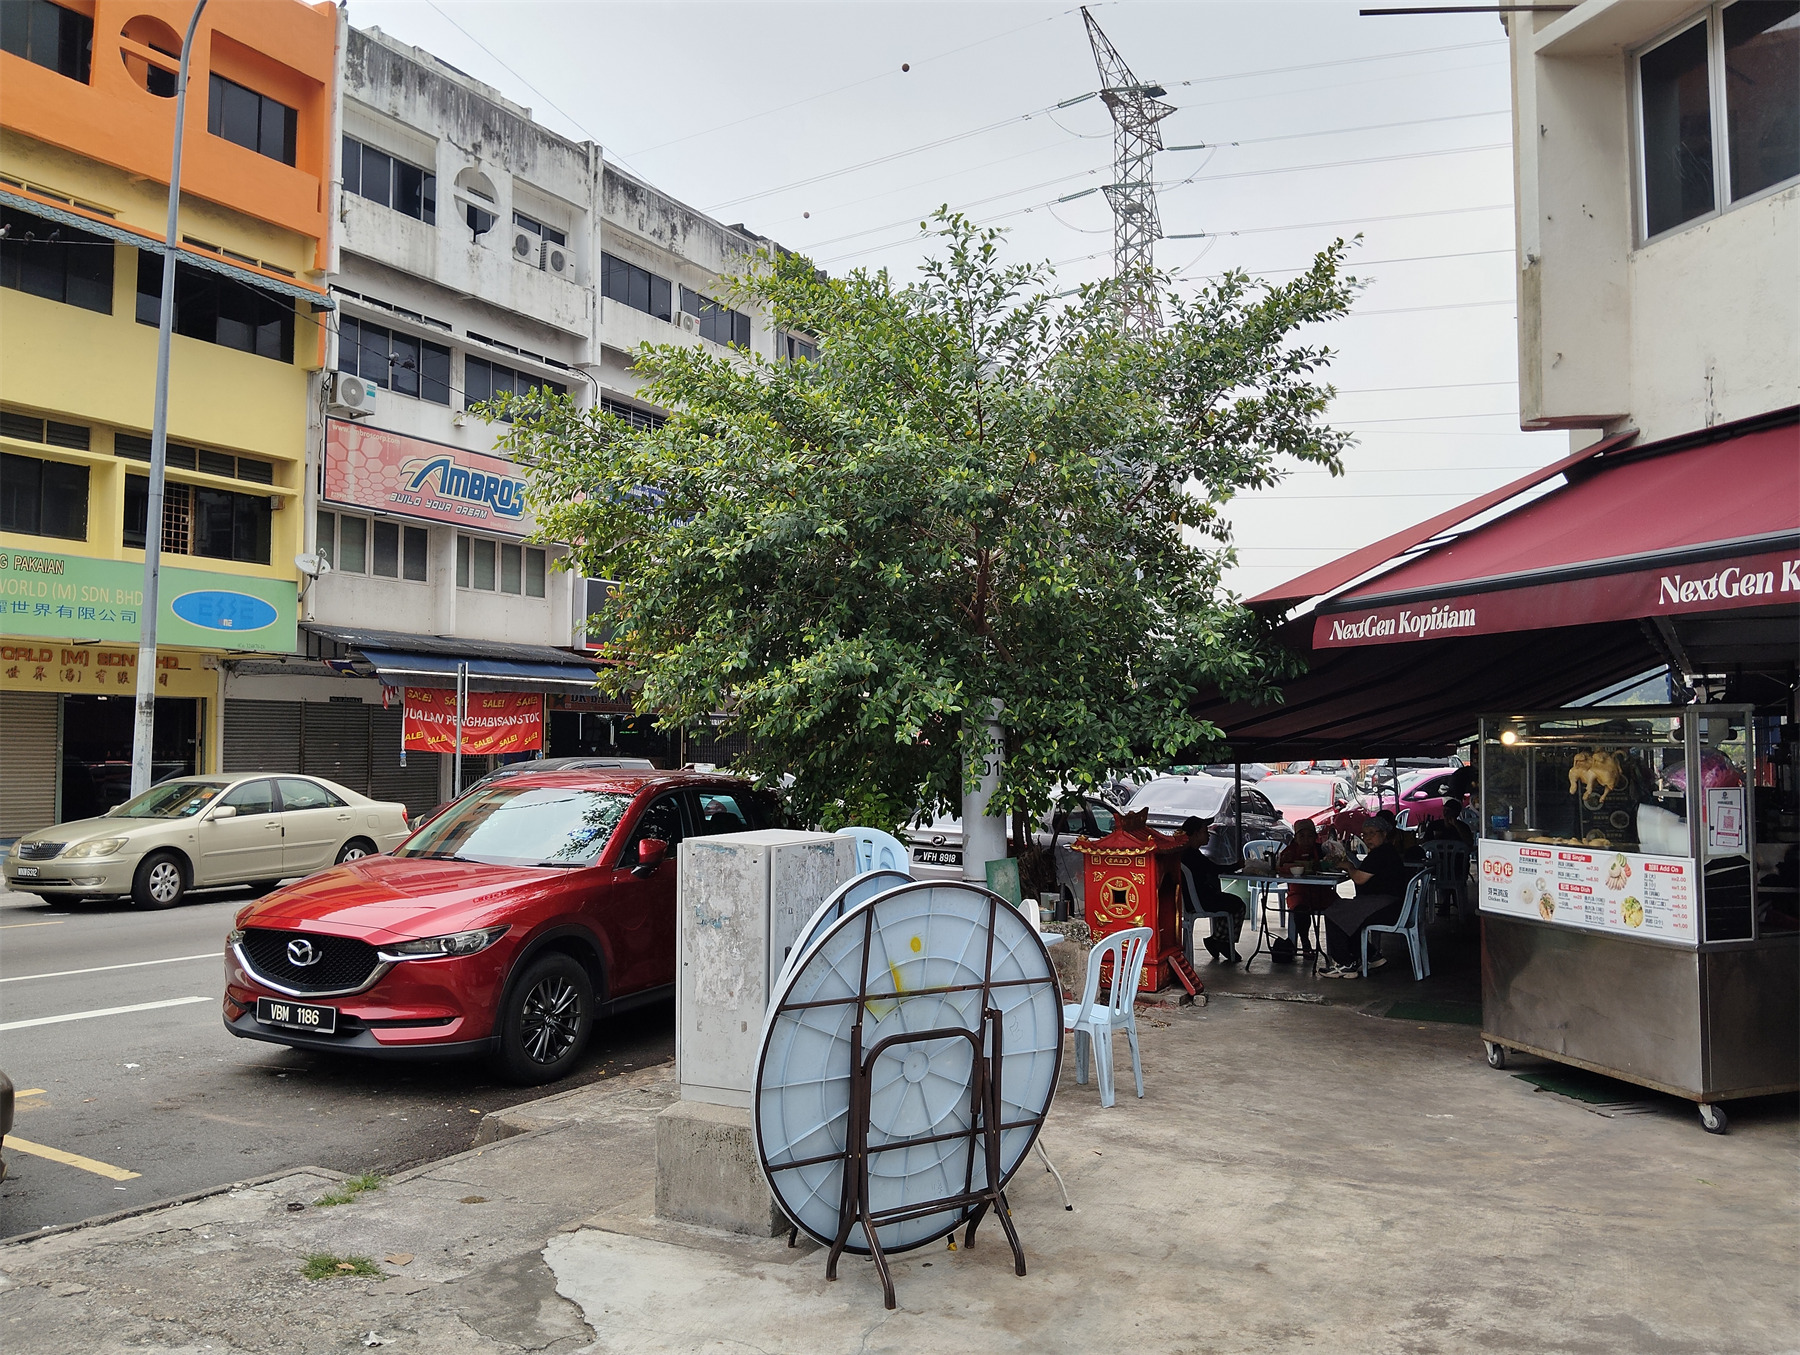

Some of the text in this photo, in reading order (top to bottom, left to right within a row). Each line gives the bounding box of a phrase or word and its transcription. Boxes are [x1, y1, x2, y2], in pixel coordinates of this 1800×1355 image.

[390, 491, 488, 519] BUILD YOUR DREAM
[13, 554, 65, 576] PAKAIAN
[52, 581, 77, 602] (M)
[1658, 567, 1775, 605] NextGen
[1328, 604, 1476, 641] NextGen Kopitiam
[0, 645, 54, 663] ORLD
[482, 698, 506, 709] SALE!
[473, 735, 494, 749] SALE!
[499, 733, 518, 748] SALE!
[923, 851, 957, 864] VFH 8918
[1570, 884, 1580, 892] Side
[270, 1003, 290, 1022] VBM
[296, 1007, 320, 1026] 1186
